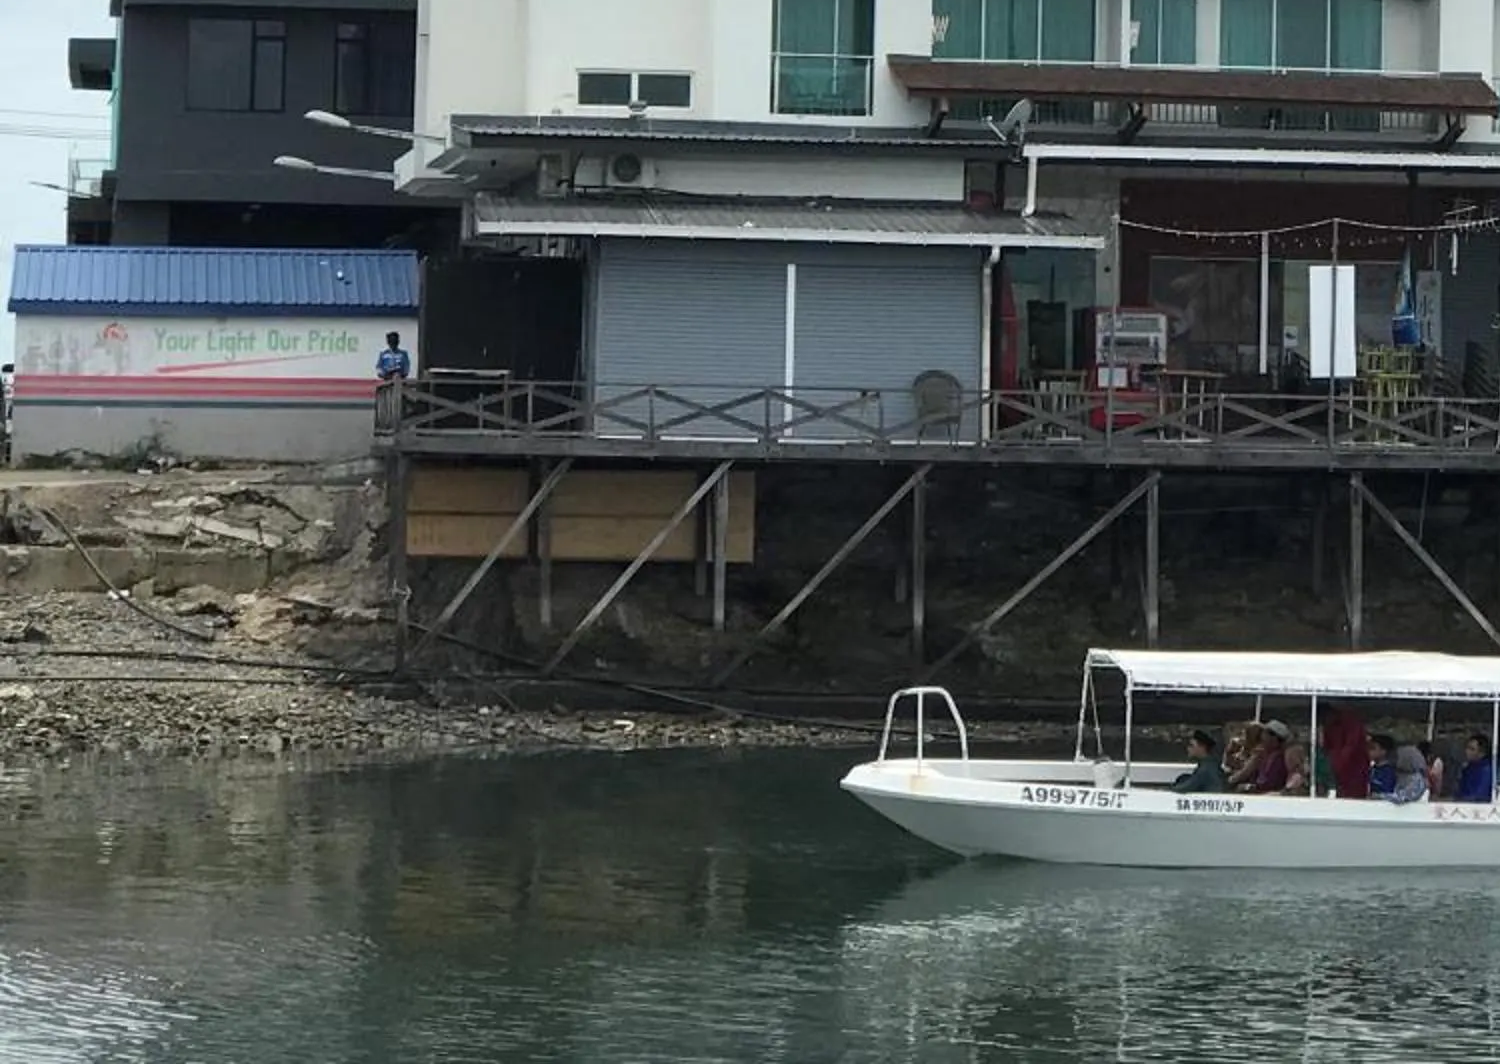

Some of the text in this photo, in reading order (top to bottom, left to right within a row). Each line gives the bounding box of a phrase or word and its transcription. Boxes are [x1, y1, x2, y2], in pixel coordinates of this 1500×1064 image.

[154, 327, 360, 361] Your Light Our Pride
